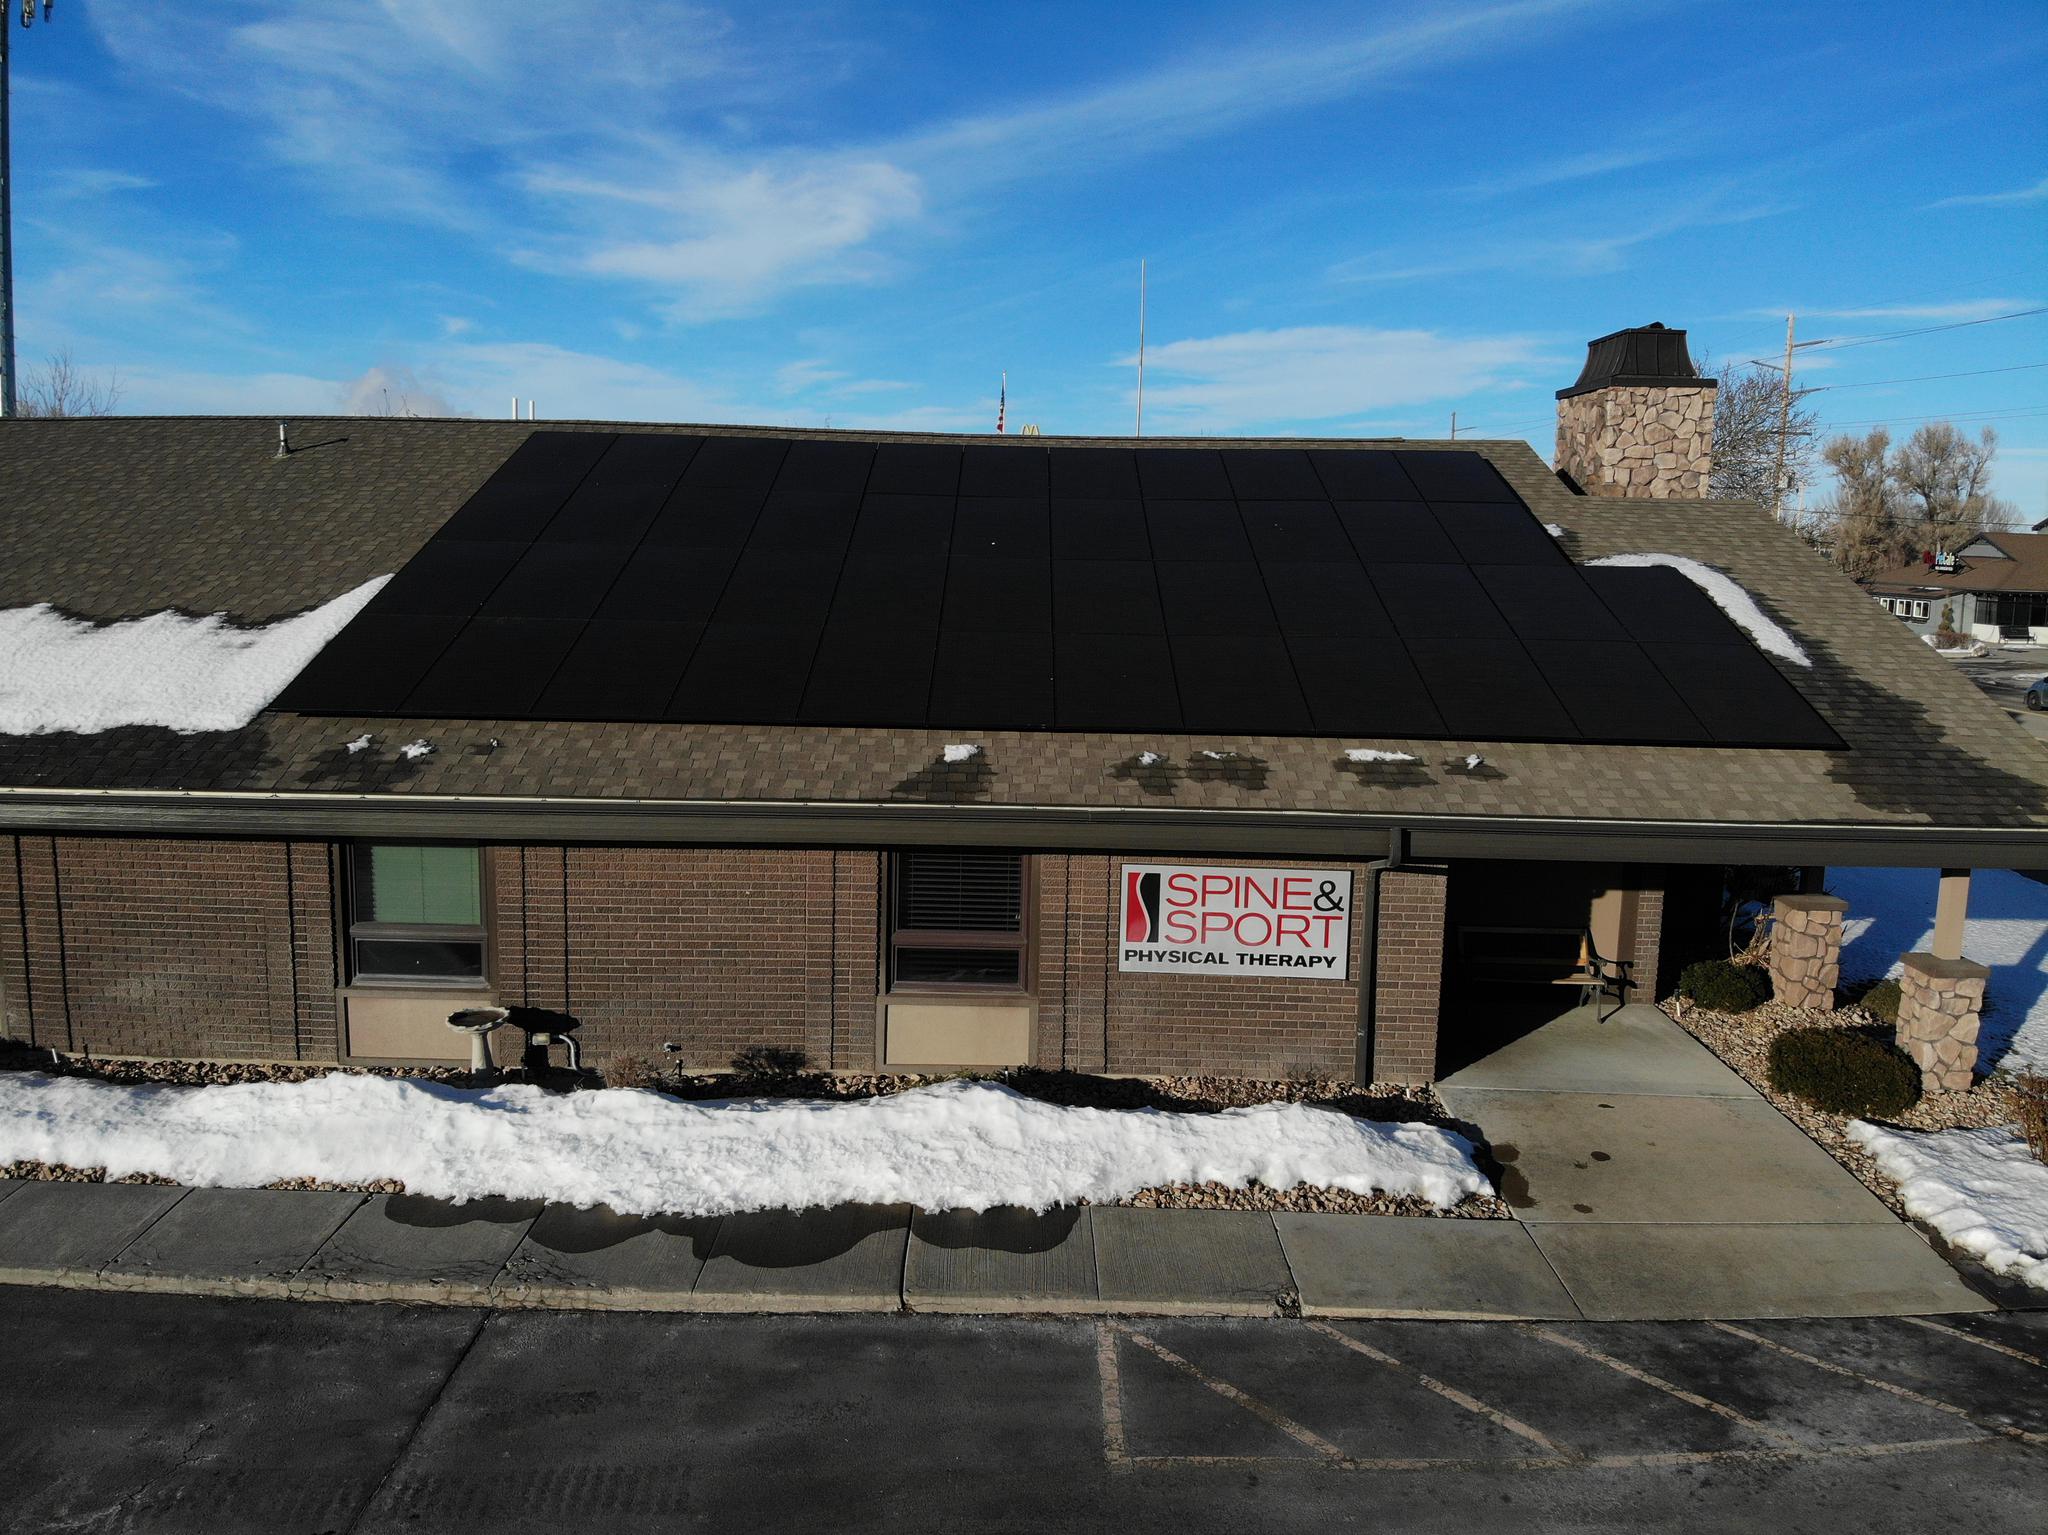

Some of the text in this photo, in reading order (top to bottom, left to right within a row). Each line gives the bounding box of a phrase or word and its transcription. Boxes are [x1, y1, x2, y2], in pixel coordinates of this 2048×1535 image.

[1164, 910, 1343, 948] SPORT
[1124, 949, 1337, 968] PHYSICAL THERAPY
